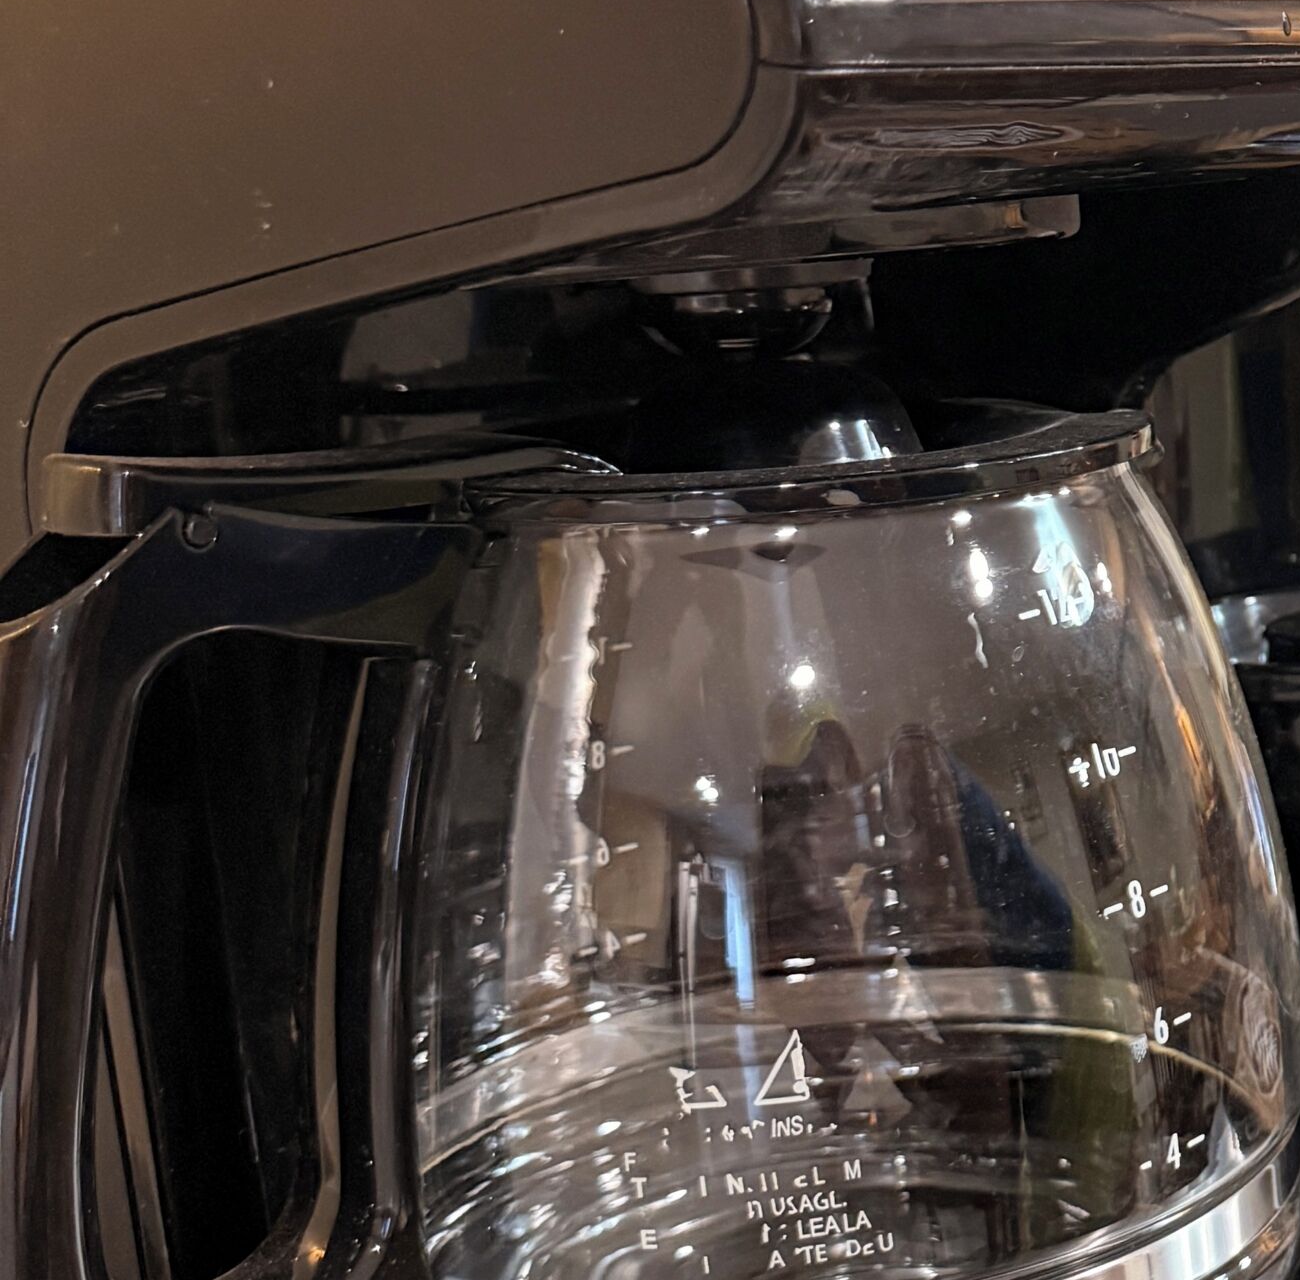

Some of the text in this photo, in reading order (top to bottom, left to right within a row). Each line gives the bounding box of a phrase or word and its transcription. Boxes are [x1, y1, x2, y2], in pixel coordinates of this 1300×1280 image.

[1127, 880, 1146, 918] 8
[1154, 1006, 1169, 1044] 6
[1166, 1132, 1182, 1170] 4
